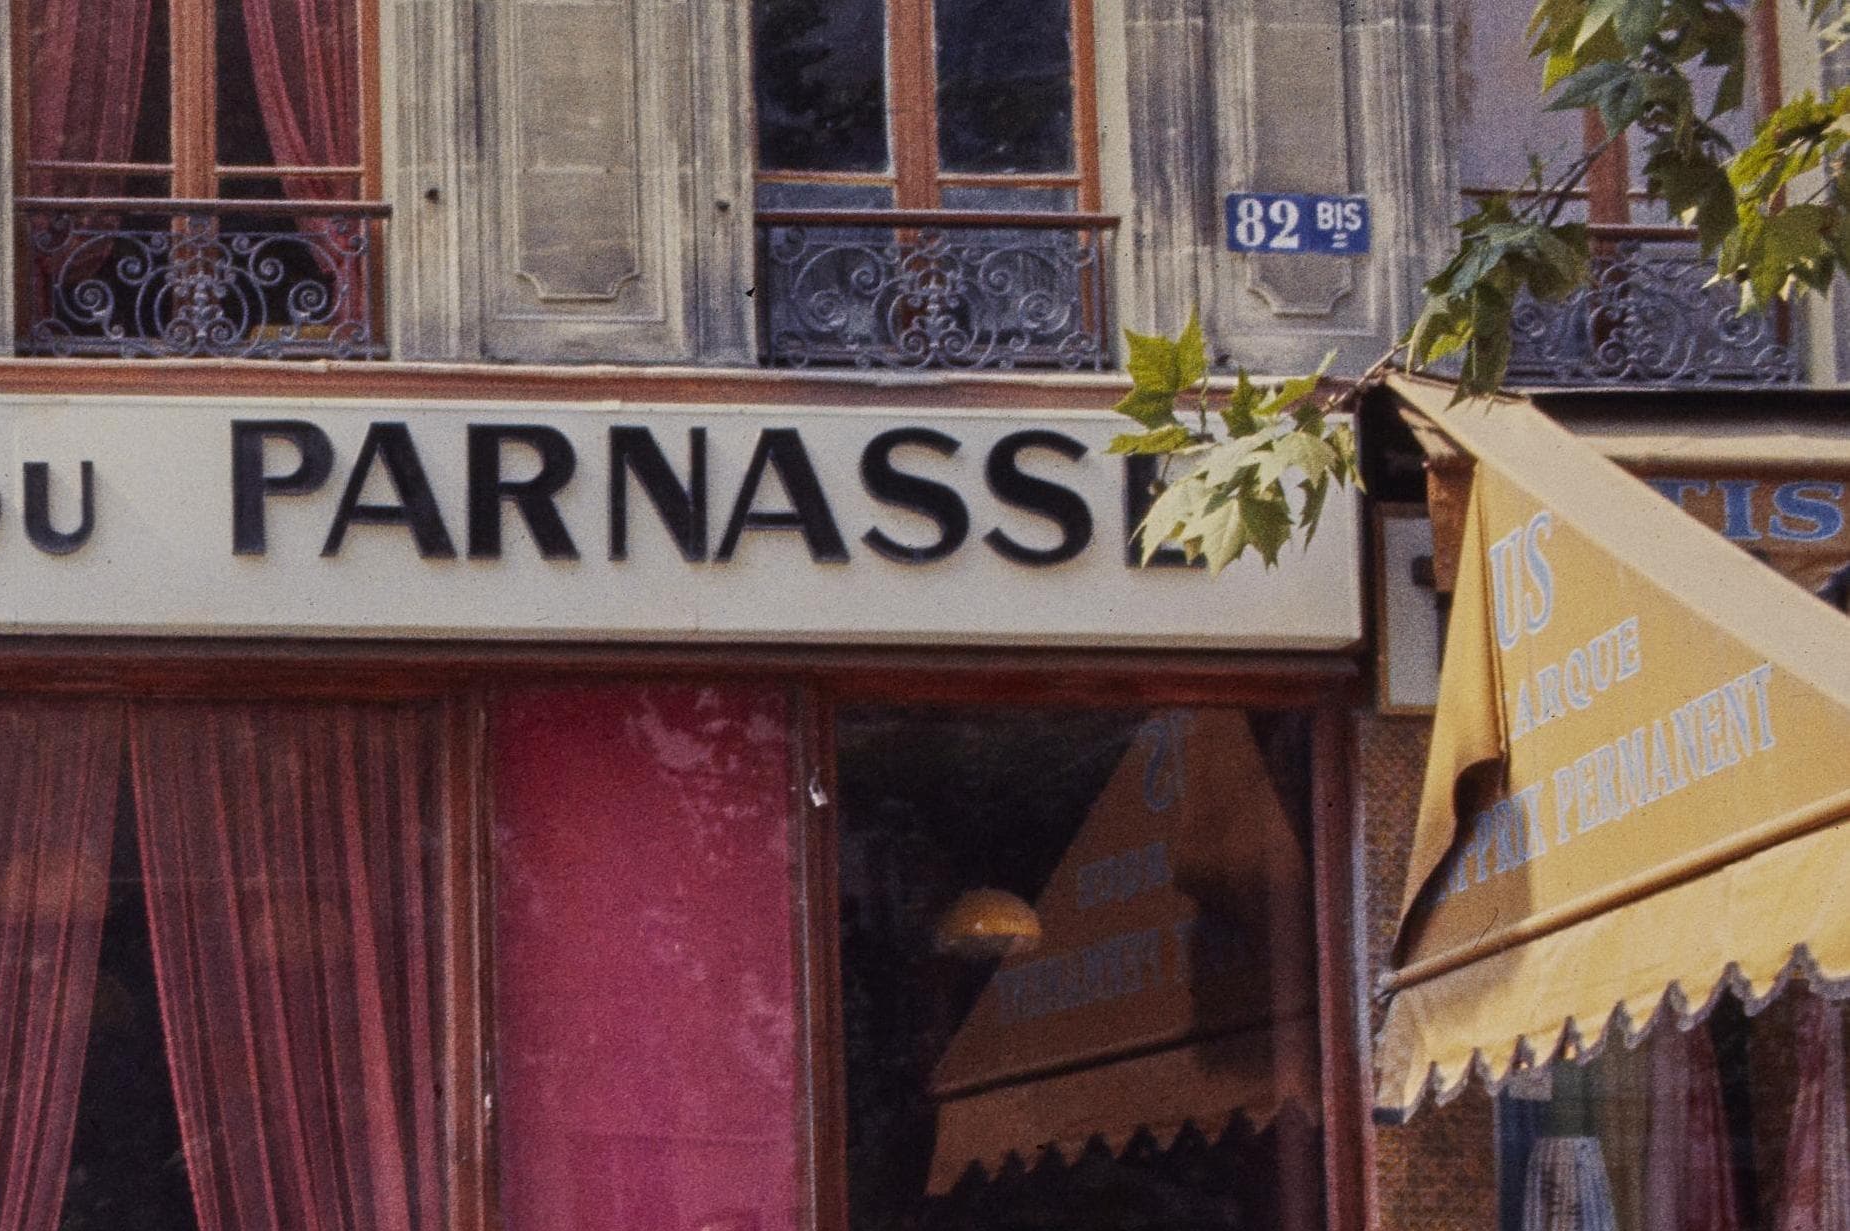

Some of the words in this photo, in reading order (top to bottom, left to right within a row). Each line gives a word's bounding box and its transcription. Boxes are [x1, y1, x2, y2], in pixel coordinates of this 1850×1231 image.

[1235, 198, 1300, 249] 82
[1316, 201, 1362, 231] BIS
[1503, 614, 1642, 742] ARQUE
[1552, 660, 1778, 846] PERMANENT
